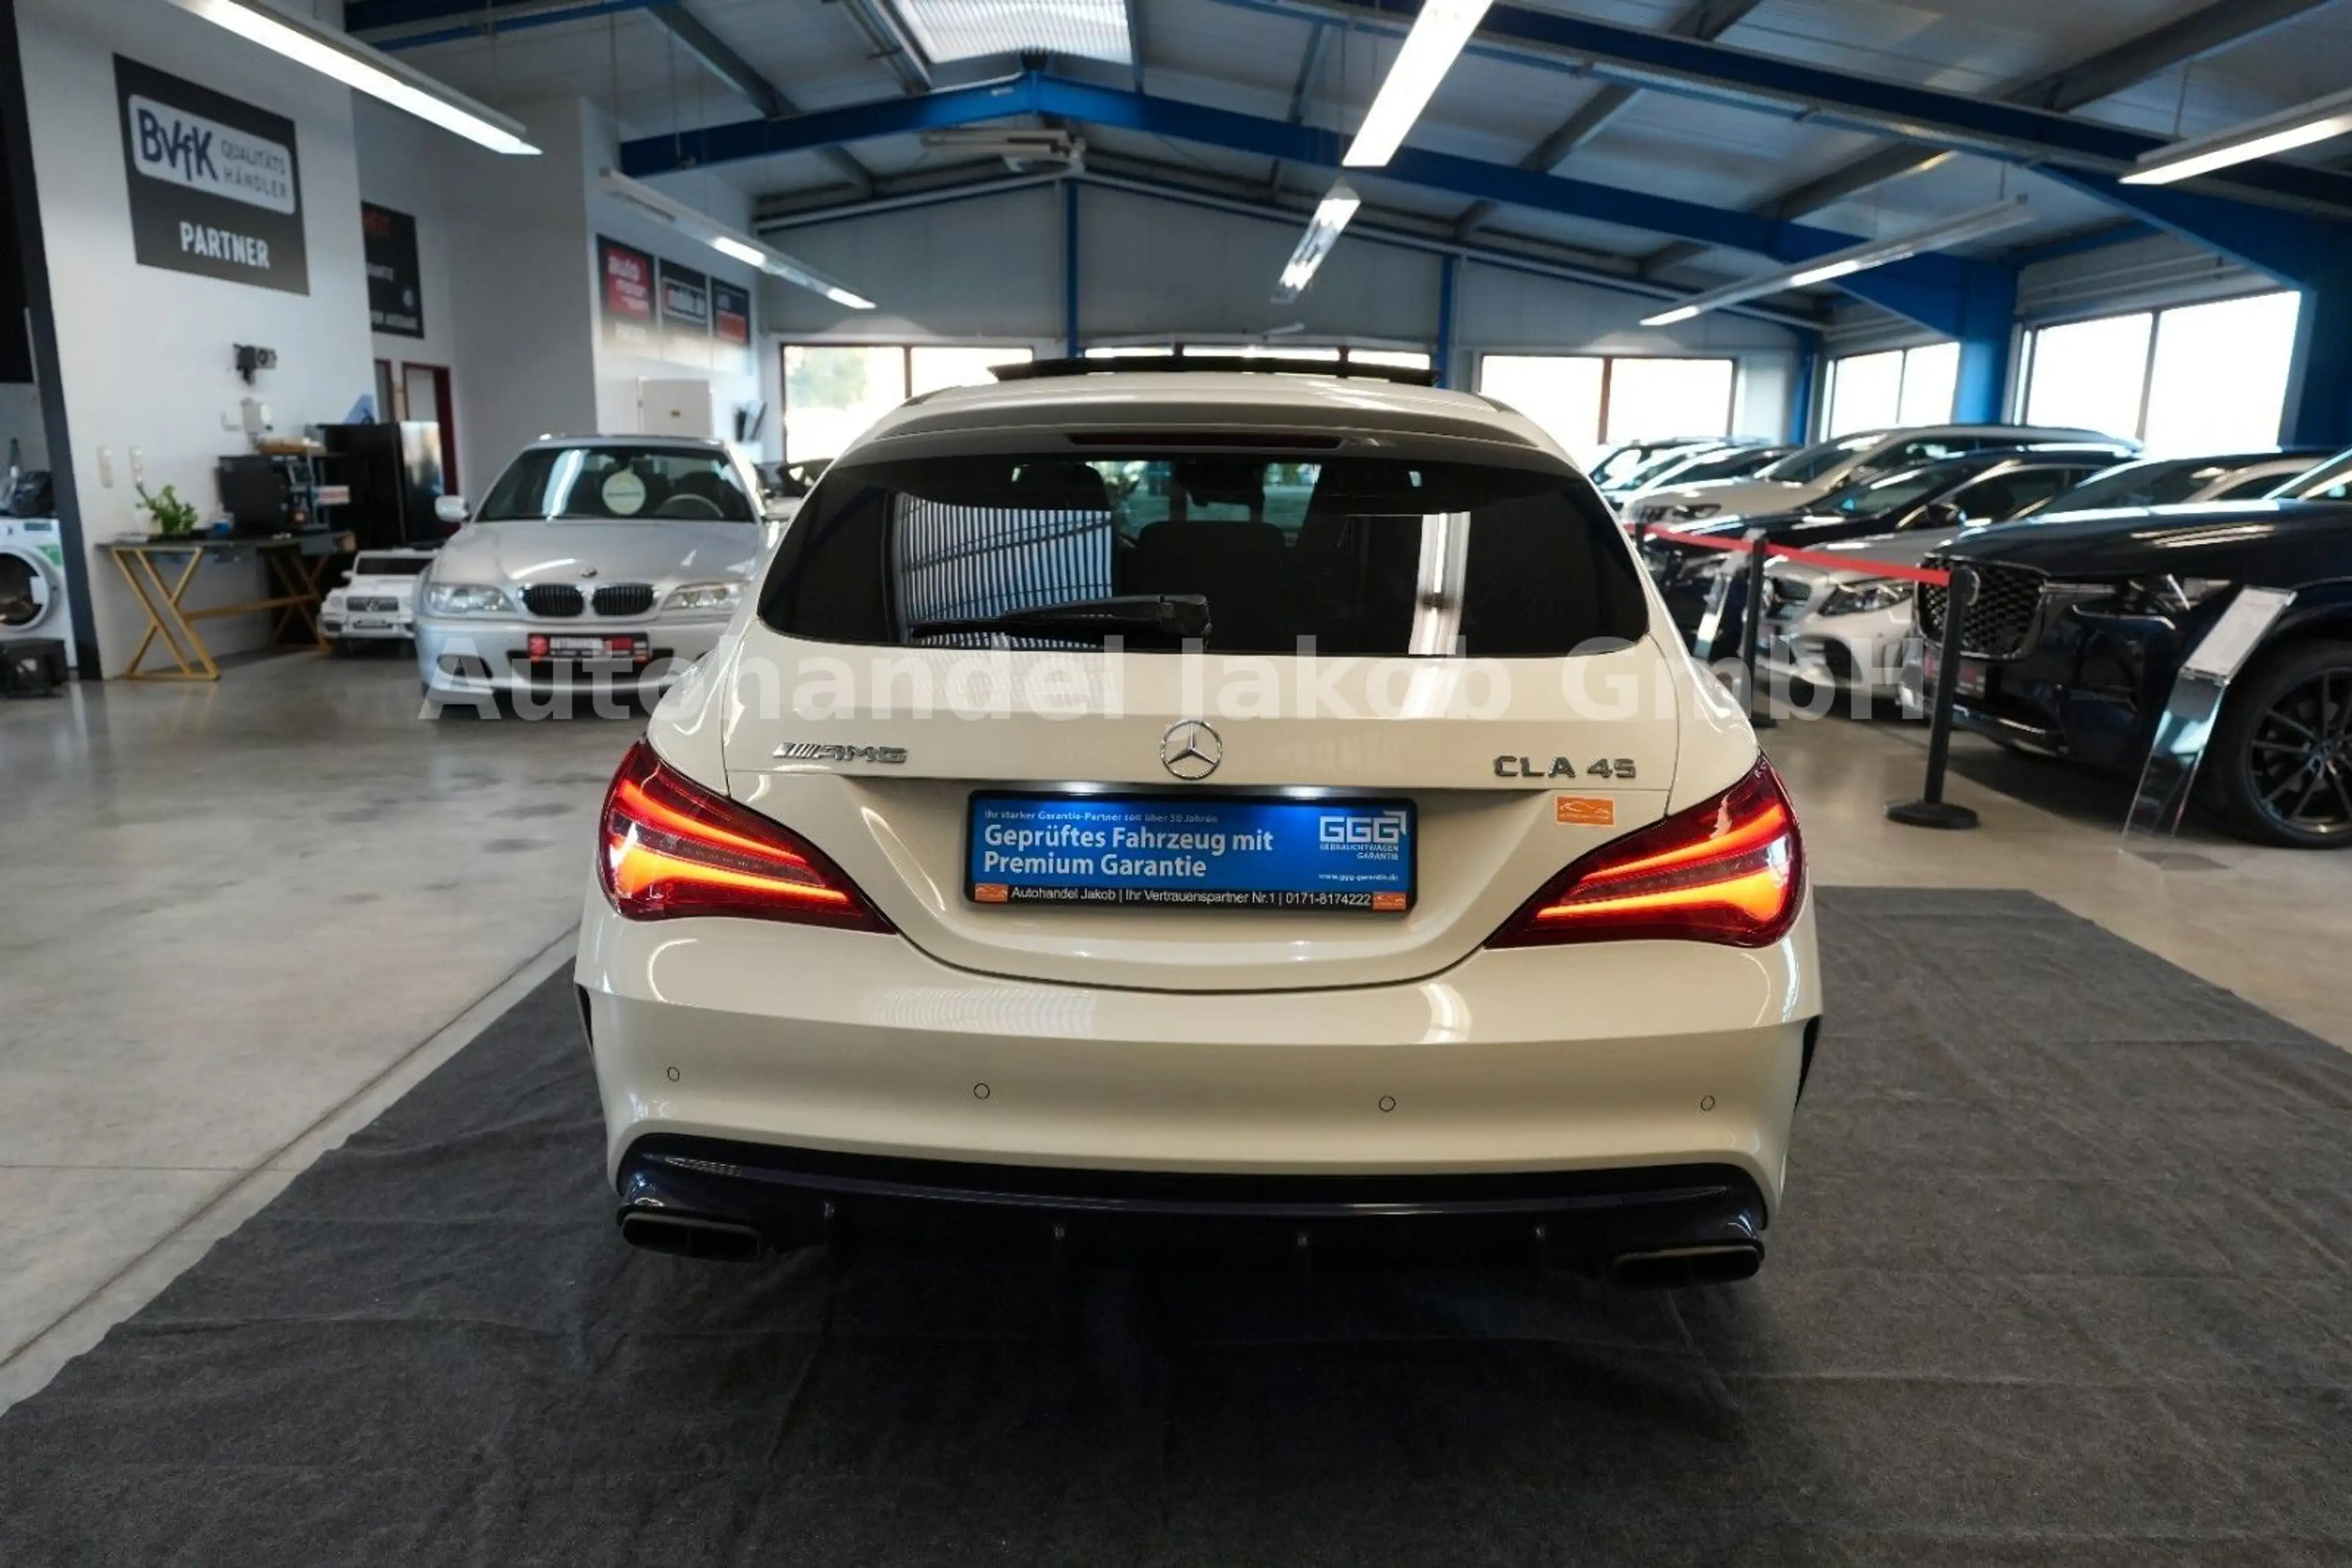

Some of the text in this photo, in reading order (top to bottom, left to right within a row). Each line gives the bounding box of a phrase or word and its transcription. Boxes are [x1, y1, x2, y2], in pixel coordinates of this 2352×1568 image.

[179, 221, 271, 270] PARTNER
[812, 743, 907, 763] AMG
[1493, 755, 1637, 778] CLA 45
[985, 810, 998, 820] Ihr
[1001, 811, 1036, 820] starker
[1038, 811, 1122, 821] Garantie-Partner
[1319, 815, 1400, 843] GGG
[985, 824, 1274, 856] Geprüftes Fahrzeug mit
[1320, 843, 1399, 852] GEBRAUCHTWAGEN
[984, 851, 1207, 877] Premium Garantie
[1356, 852, 1399, 861] GARANTIE
[1011, 886, 1079, 900] Autohandel
[1080, 888, 1117, 900] Jakob
[1126, 889, 1142, 901] Ihr
[1144, 889, 1249, 905] Vertrauenspartner
[1286, 892, 1371, 906] 0171-8174222
